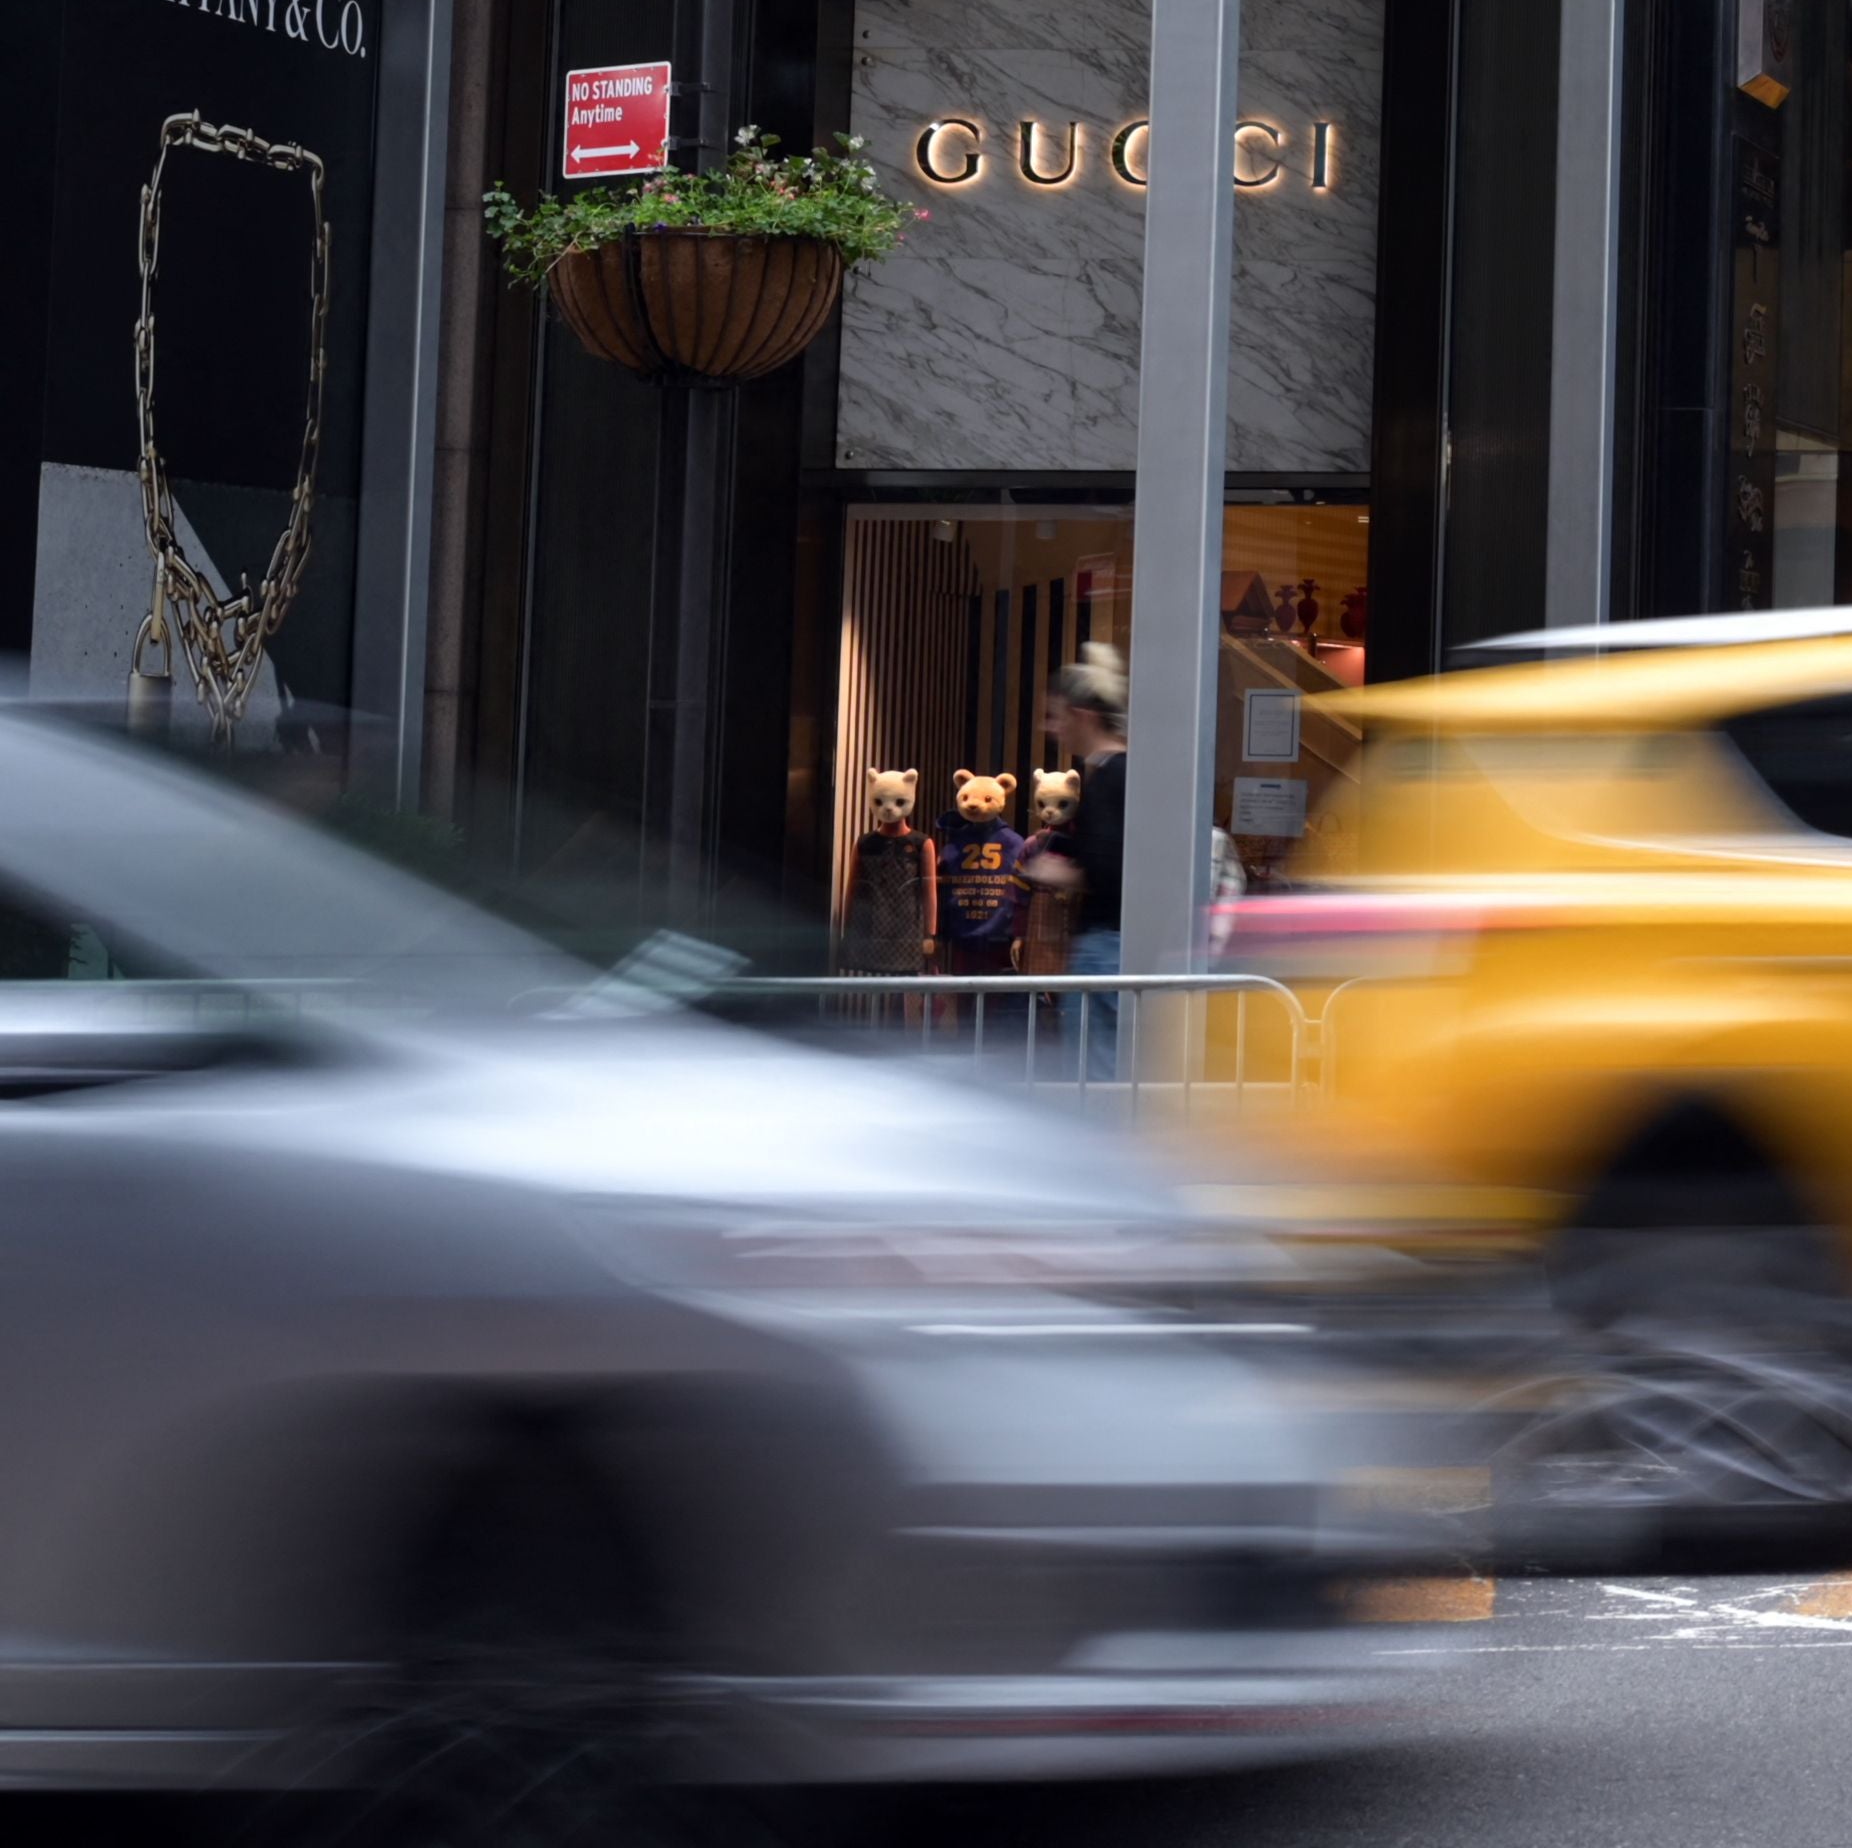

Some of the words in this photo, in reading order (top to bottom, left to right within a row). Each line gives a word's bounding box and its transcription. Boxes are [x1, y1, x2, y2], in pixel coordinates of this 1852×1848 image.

[571, 82, 590, 103] NO
[592, 76, 653, 101] STANDING
[571, 103, 623, 129] Anytime
[915, 118, 1330, 189] GUCCI
[961, 842, 1003, 870] 25
